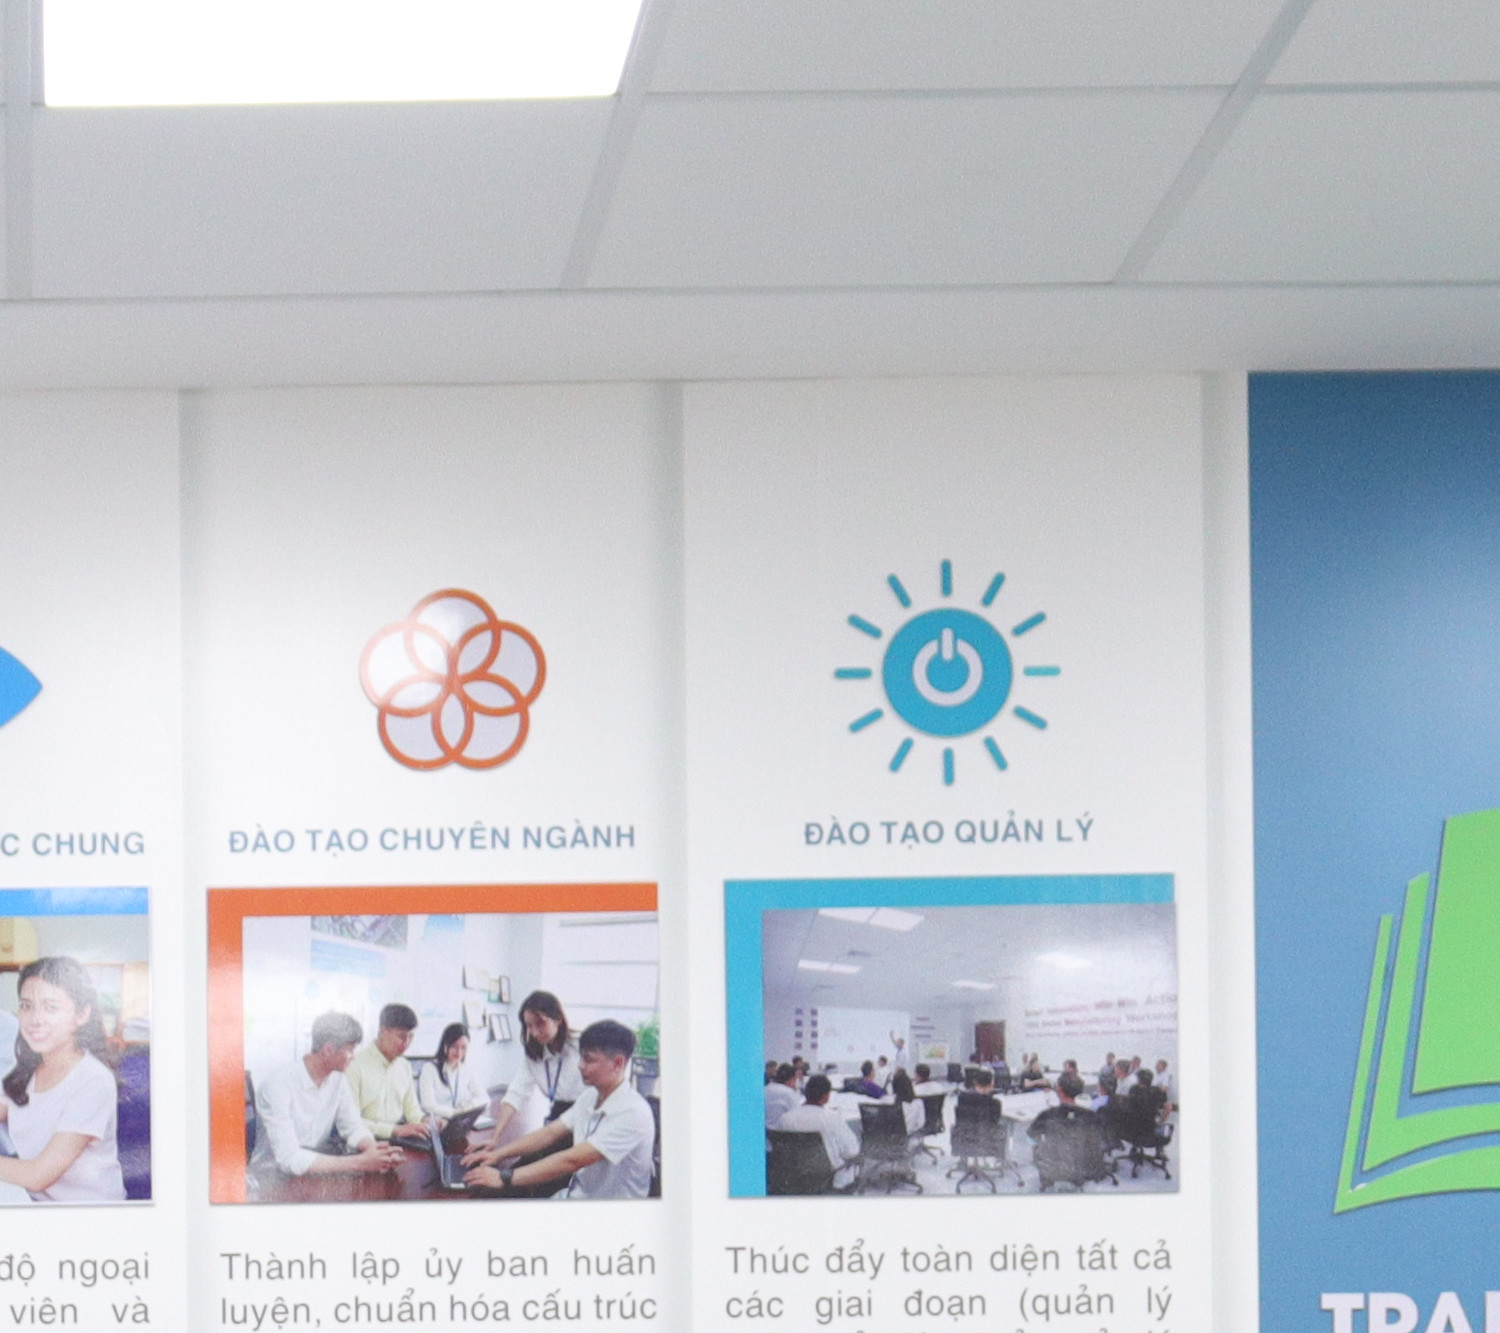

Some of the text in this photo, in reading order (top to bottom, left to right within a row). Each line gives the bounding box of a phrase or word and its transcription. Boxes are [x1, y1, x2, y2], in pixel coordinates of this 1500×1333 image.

[31, 831, 145, 857] CHUNG
[228, 819, 635, 858] ĐÀO TẠO CHUYÊN NGÀNH
[803, 809, 1094, 850] ĐÀO TẠO QUẢN LÝ
[58, 1252, 149, 1291] ngoại
[219, 1243, 656, 1286] Thành lập ủy ban huấn
[724, 1237, 1172, 1281] Thúc đẩy toàn diện tất cả
